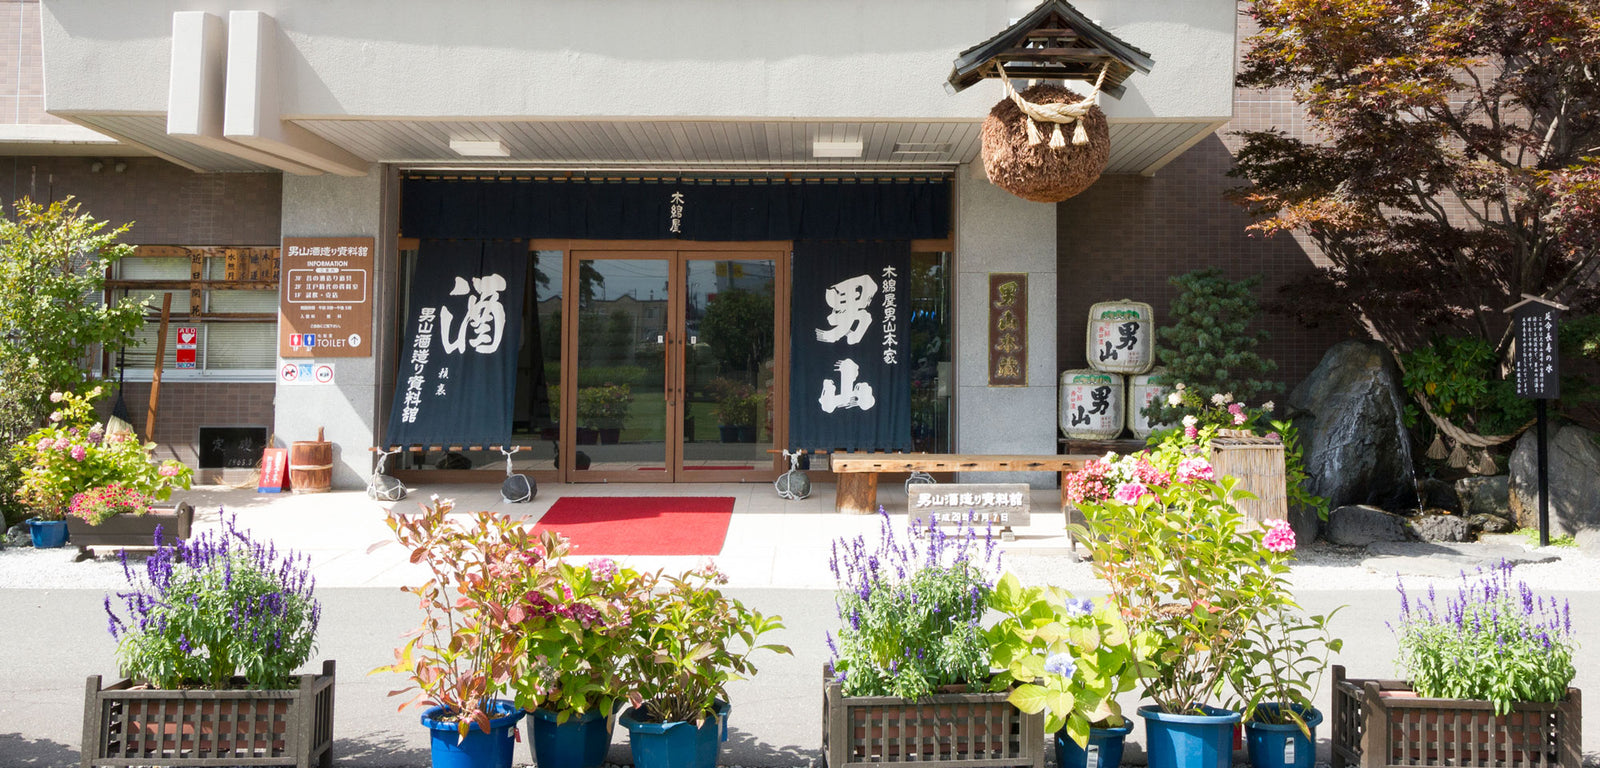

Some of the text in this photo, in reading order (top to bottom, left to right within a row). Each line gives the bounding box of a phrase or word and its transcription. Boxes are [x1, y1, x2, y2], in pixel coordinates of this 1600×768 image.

[669, 191, 685, 234] 木綿屋
[440, 273, 507, 355] 酒
[881, 264, 898, 365] 木綿屋男山本家
[317, 339, 346, 348] TOILET
[815, 274, 878, 414] 男山
[1099, 321, 1140, 362] 男山
[1544, 311, 1553, 374] 延命長寿の水
[1071, 385, 1112, 427] 男山
